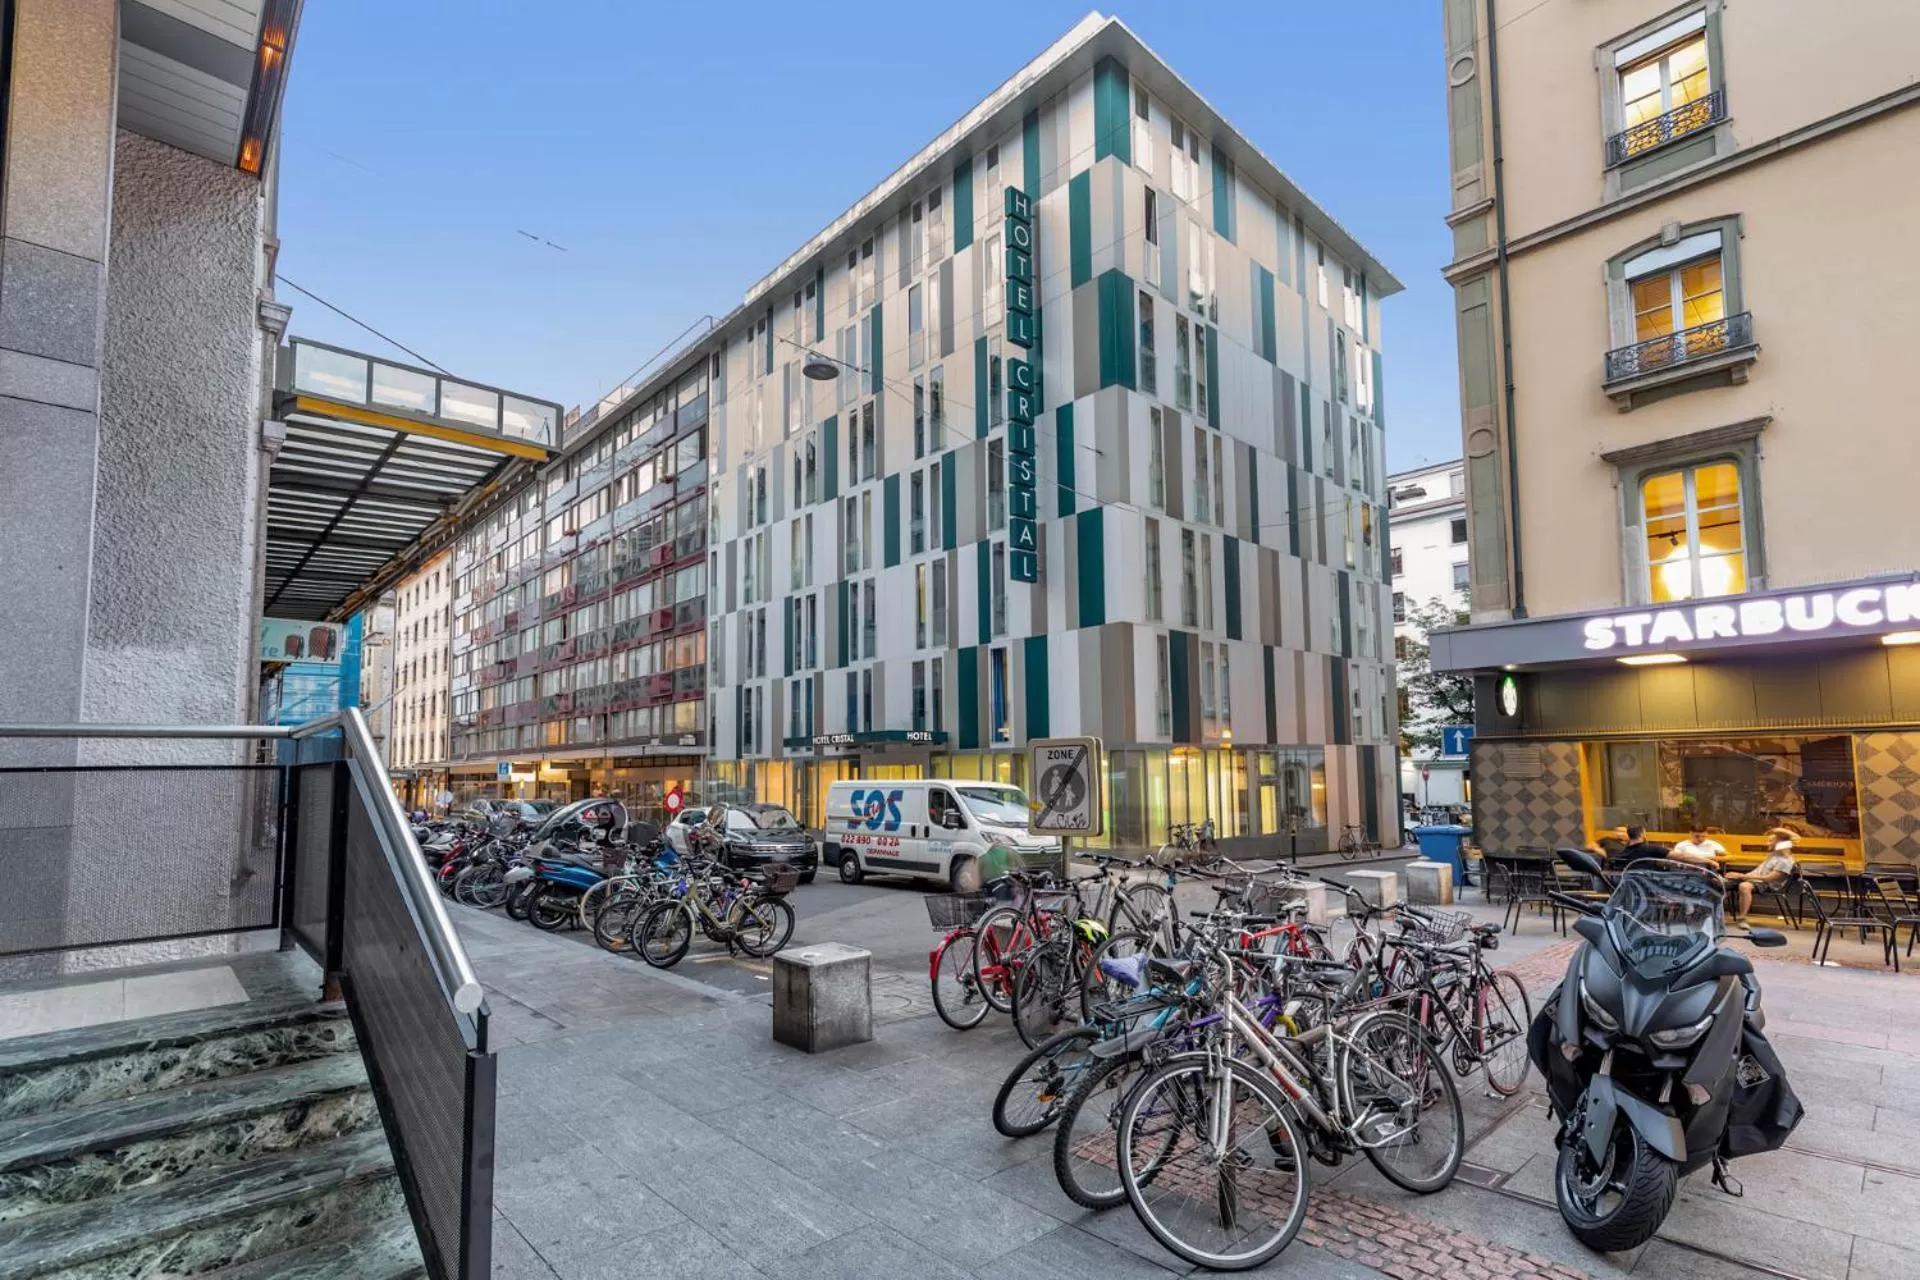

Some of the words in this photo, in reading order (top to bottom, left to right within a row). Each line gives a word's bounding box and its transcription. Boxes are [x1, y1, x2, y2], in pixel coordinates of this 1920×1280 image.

[1014, 192, 1029, 340] HOTEL
[1016, 365, 1033, 577] CRISTAL
[1583, 583, 1920, 650] STARBUCK
[812, 735, 830, 745] HOTEL
[906, 731, 933, 741] HOTEL
[1047, 749, 1074, 760] ZONE
[847, 789, 904, 831] SOS
